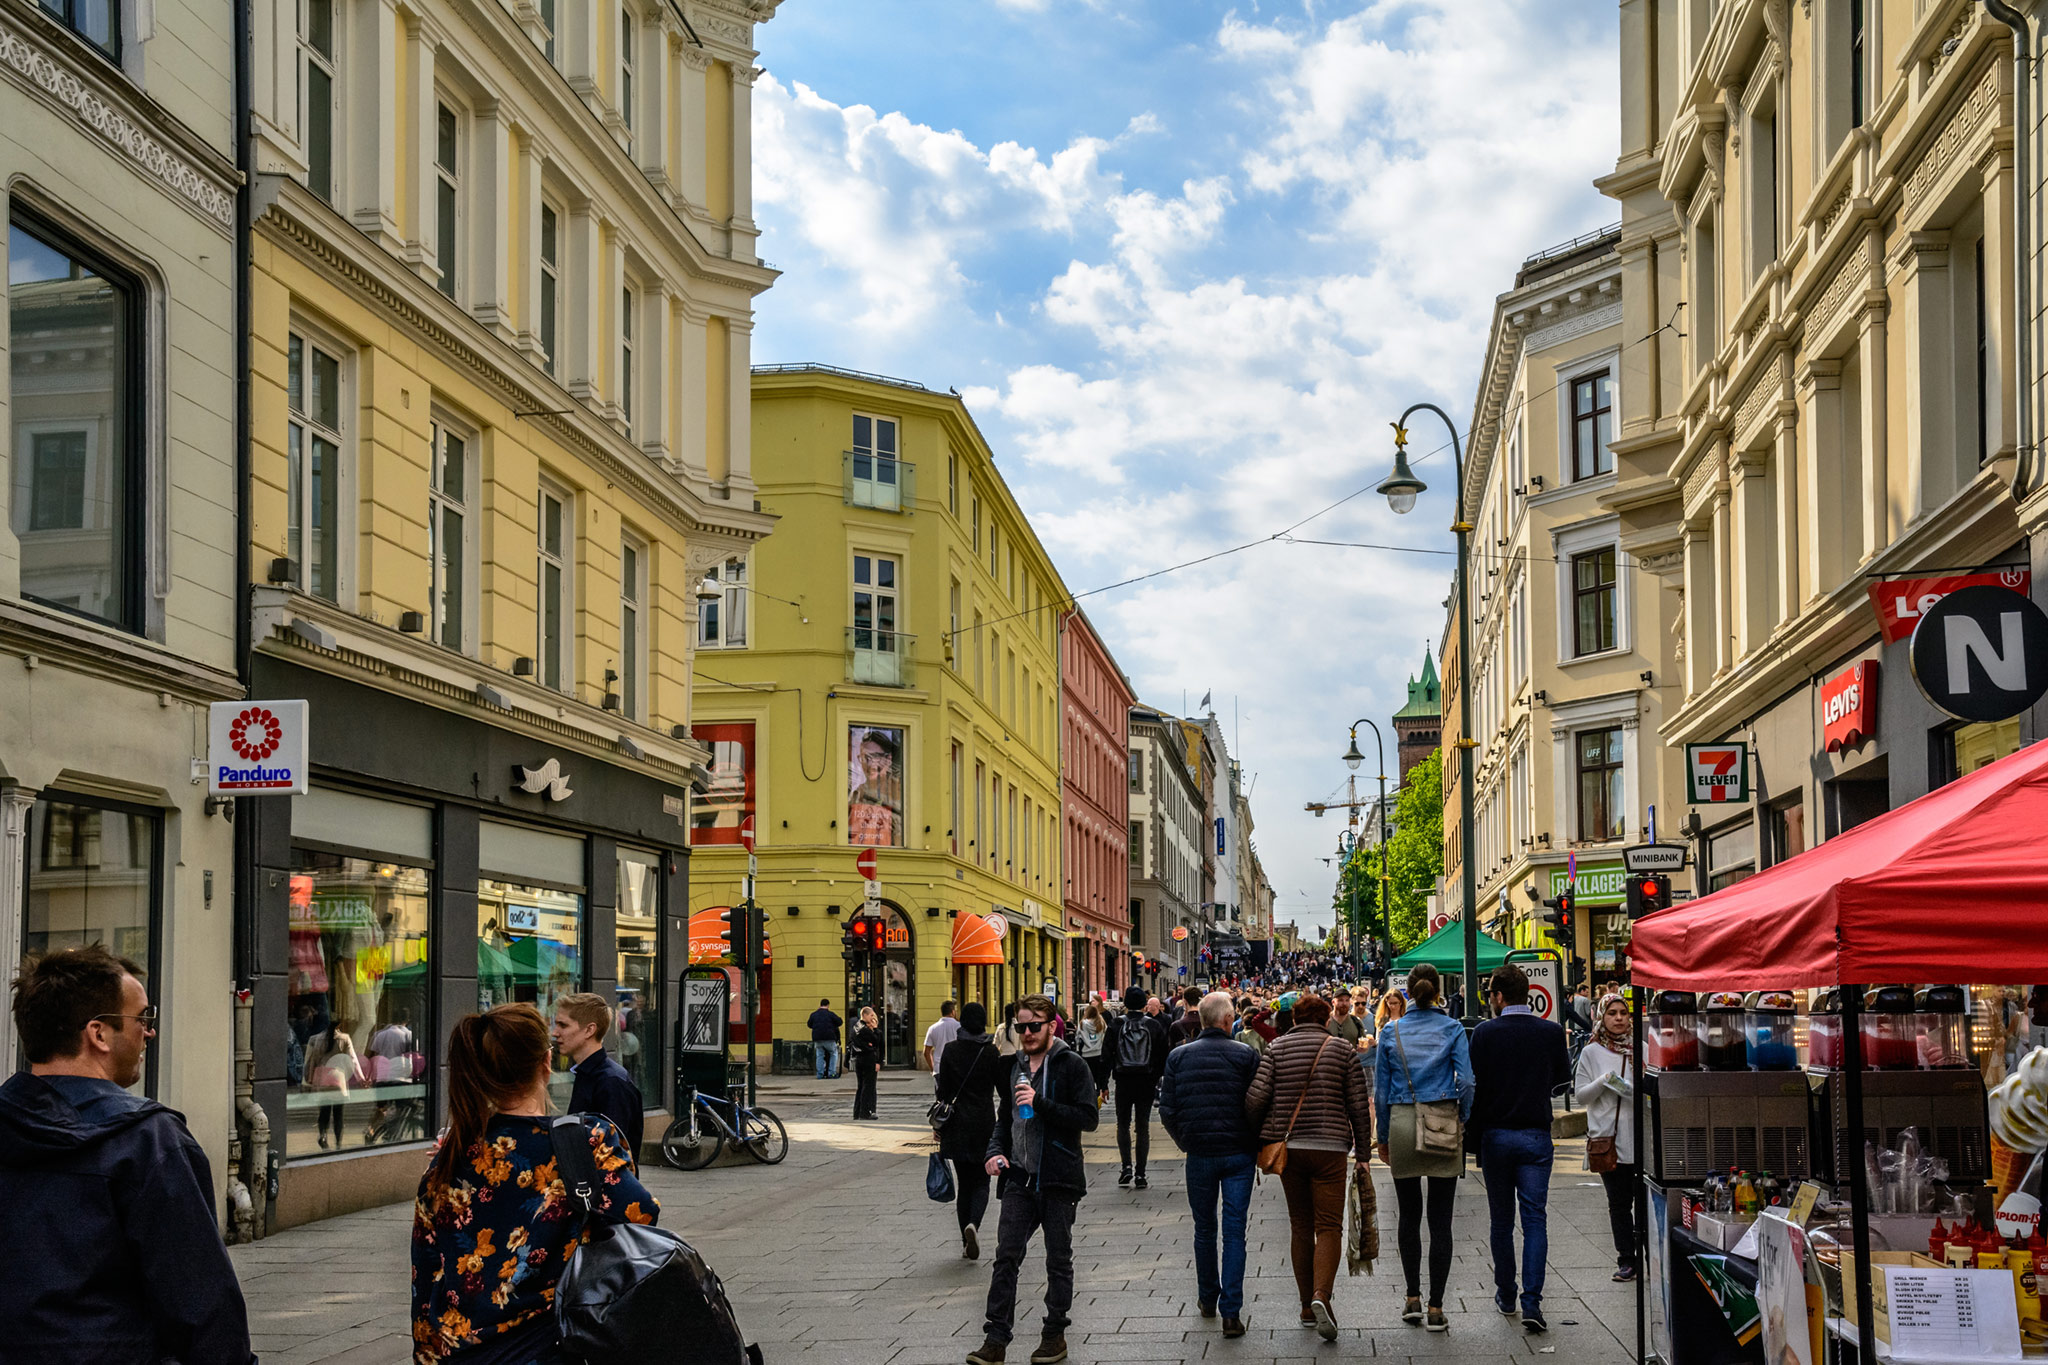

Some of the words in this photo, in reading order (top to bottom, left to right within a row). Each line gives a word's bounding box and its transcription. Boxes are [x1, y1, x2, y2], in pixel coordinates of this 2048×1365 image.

[1944, 611, 2027, 694] N
[1586, 747, 1601, 758] UFF
[218, 764, 291, 782] Panduro
[1632, 853, 1679, 863] MINIBANK
[1393, 978, 1408, 986] Son
